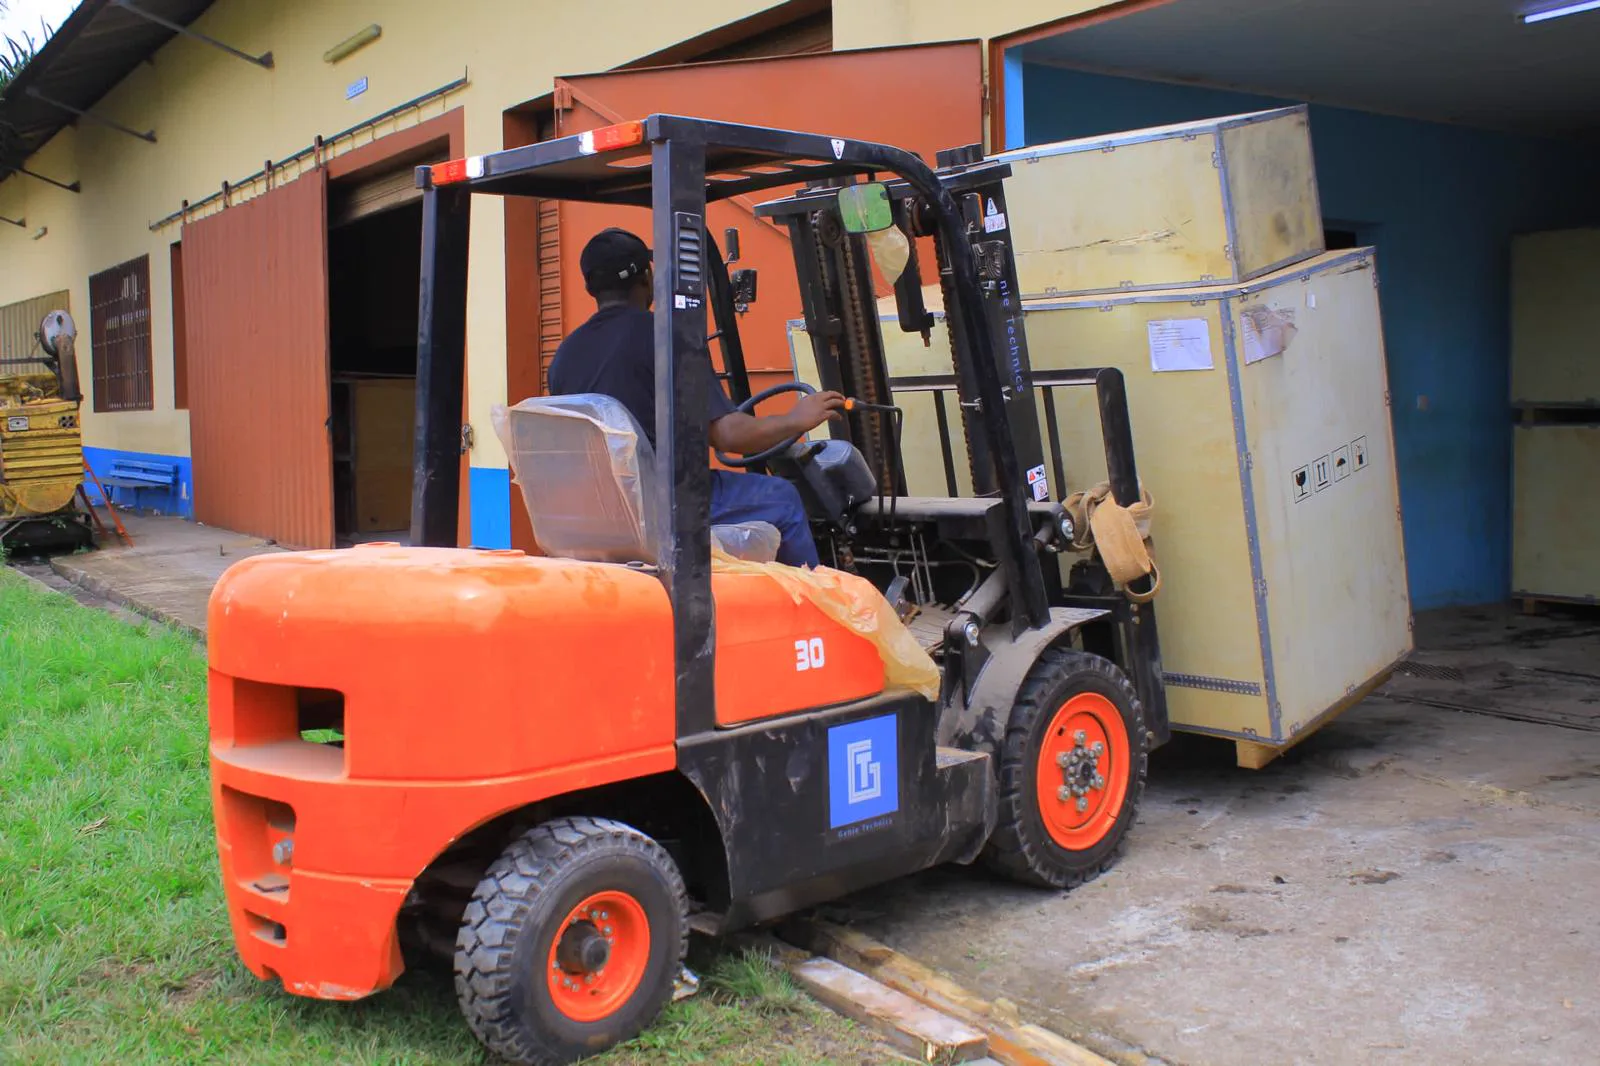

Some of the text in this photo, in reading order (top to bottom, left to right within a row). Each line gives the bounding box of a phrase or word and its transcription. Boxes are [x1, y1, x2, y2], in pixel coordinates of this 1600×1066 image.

[1000, 280, 1024, 393] nie Technics
[795, 637, 825, 671] 30
